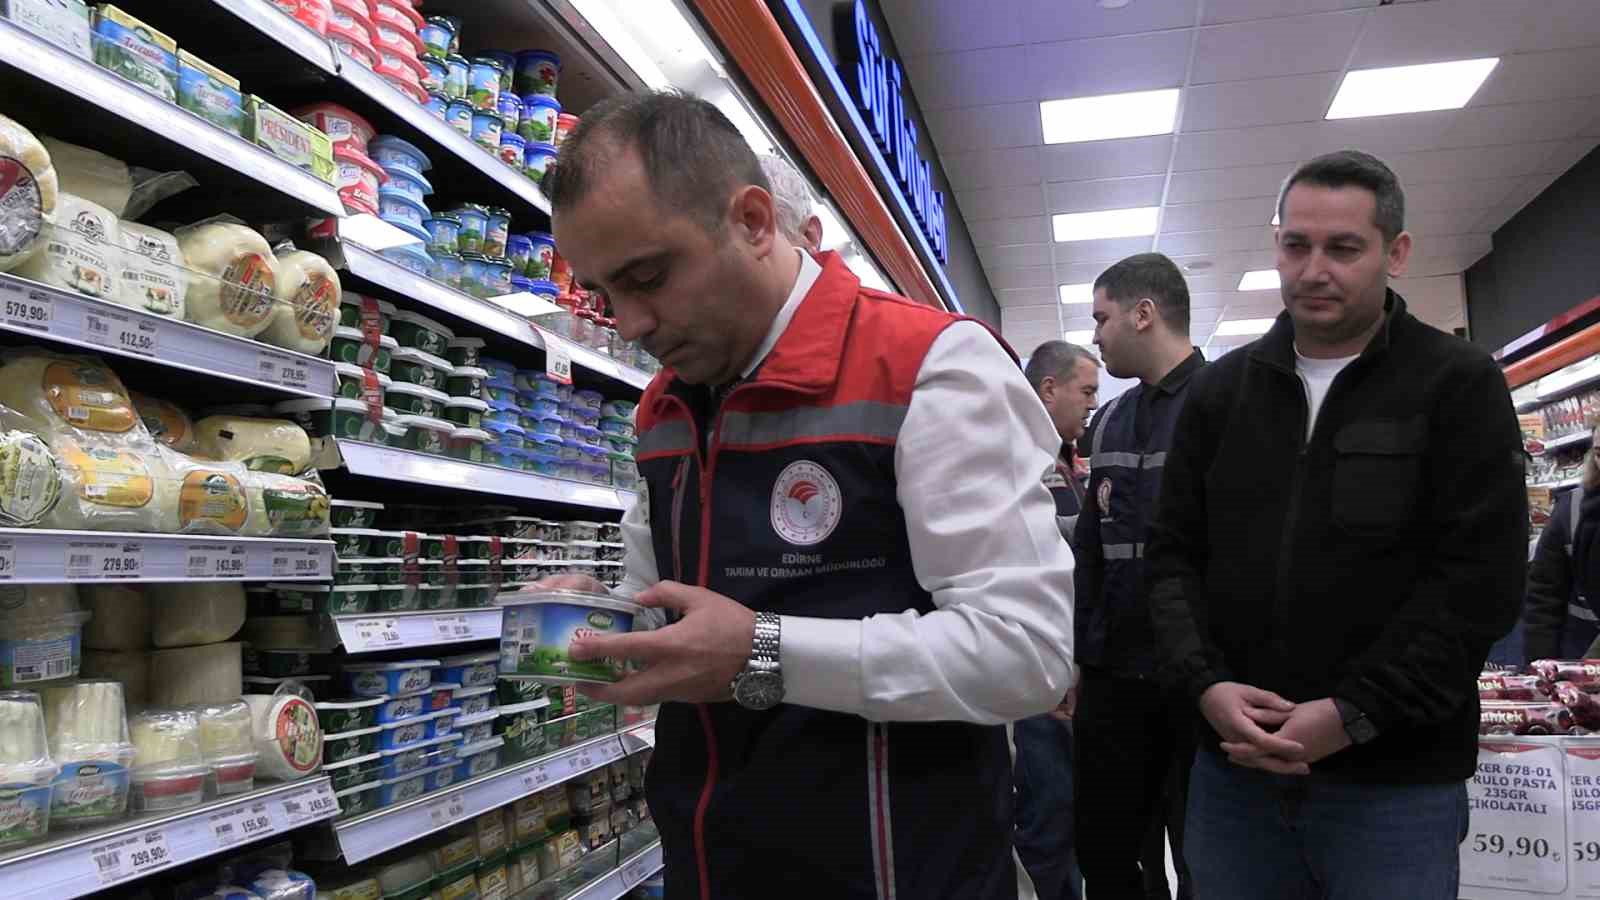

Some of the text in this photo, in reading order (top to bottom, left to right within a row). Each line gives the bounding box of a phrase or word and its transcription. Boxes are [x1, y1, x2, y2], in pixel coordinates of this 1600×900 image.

[782, 552, 823, 565] EDİRNE
[725, 567, 755, 577] TARIM
[757, 567, 768, 577] VE
[771, 567, 813, 578] ORMAN
[1505, 764, 1552, 777] 678-01
[1473, 774, 1557, 790] RULO PASTA
[1484, 787, 1528, 800] 235GR
